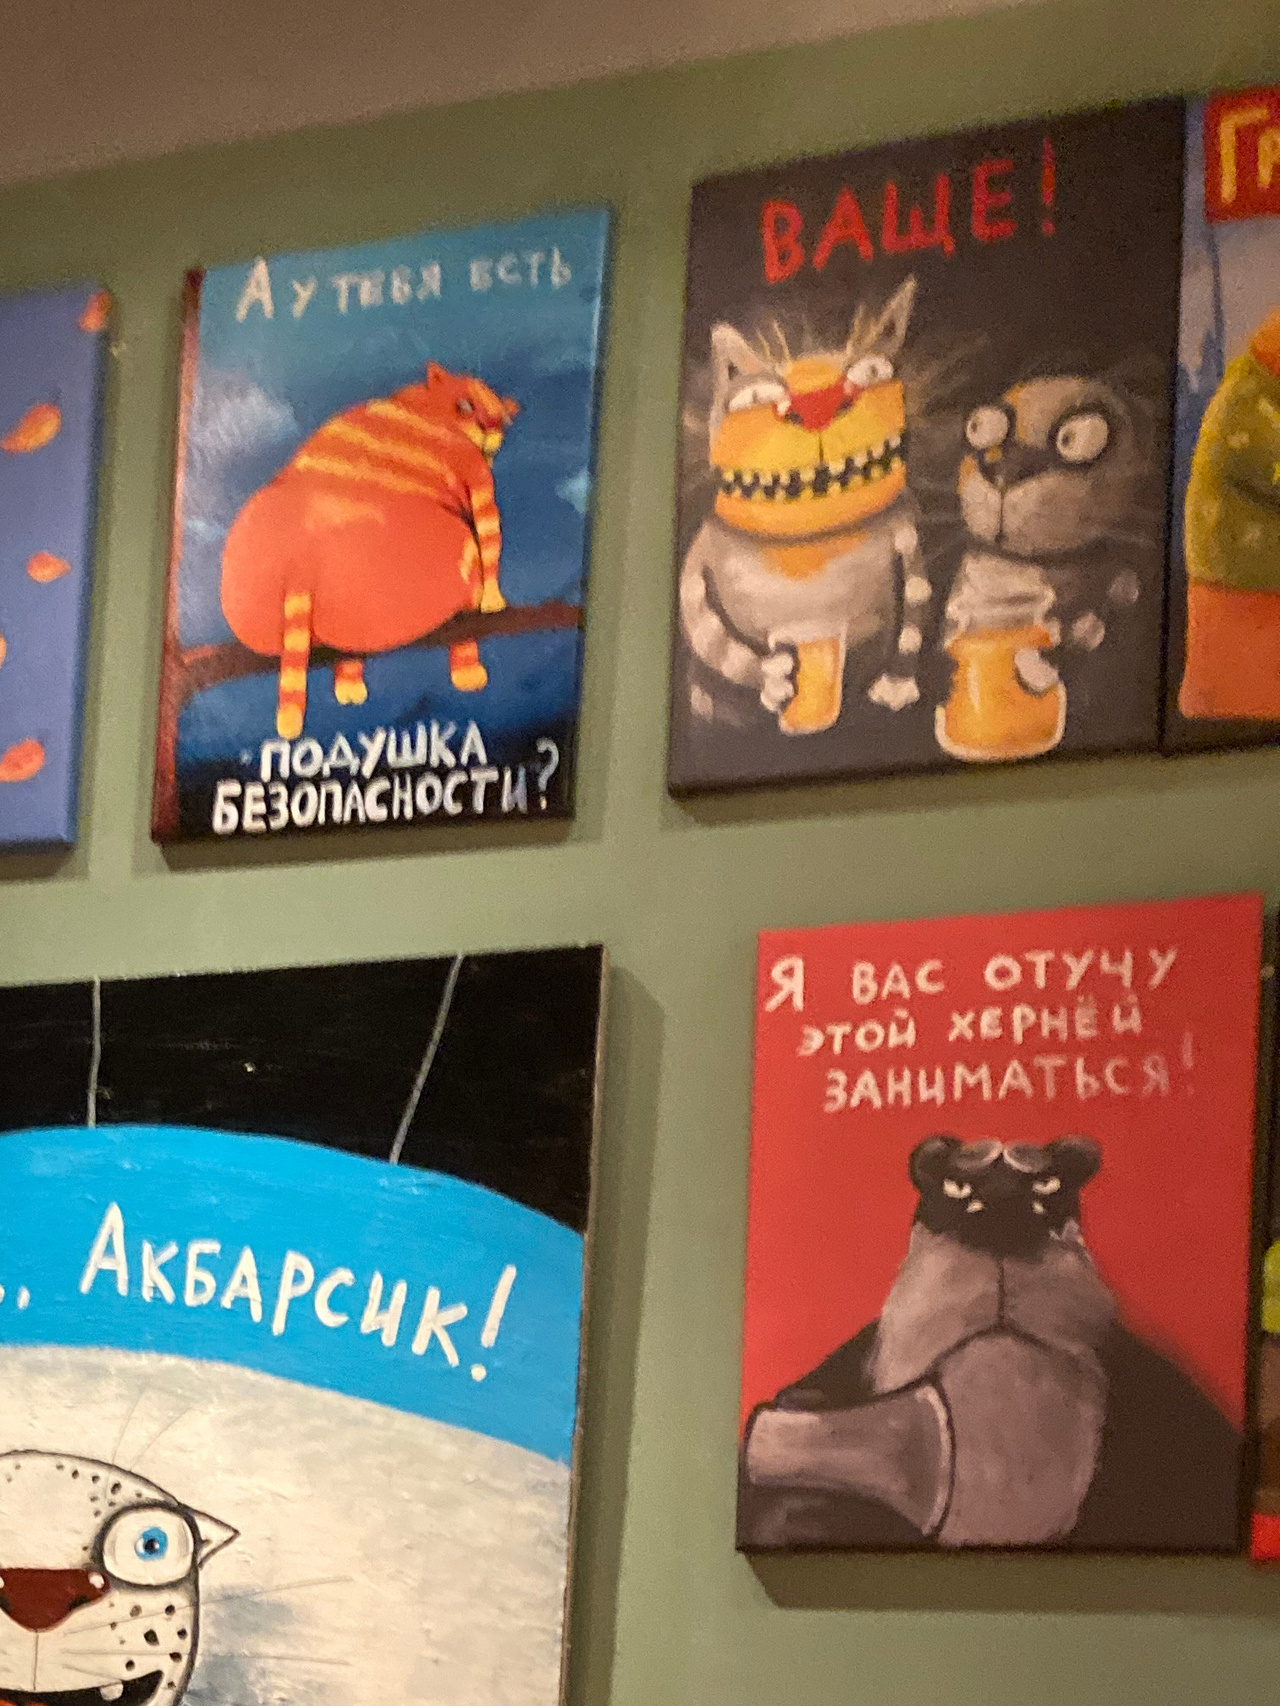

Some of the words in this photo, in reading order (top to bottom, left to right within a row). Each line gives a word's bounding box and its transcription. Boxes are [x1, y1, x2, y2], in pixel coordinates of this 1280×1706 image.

[761, 137, 1056, 284] ВАЩЕ!
[234, 255, 275, 324] А
[260, 718, 488, 783] ПОДУШКА
[212, 736, 560, 835] БЕЗОПАСНОСТИ?
[764, 954, 806, 1013] Я
[850, 957, 946, 1006] ВАС
[983, 946, 1179, 991] ОТУЧУ
[797, 1007, 918, 1058] ЭТОЙ
[822, 1031, 1195, 1114] ЗАНИМАТЬСЯ!
